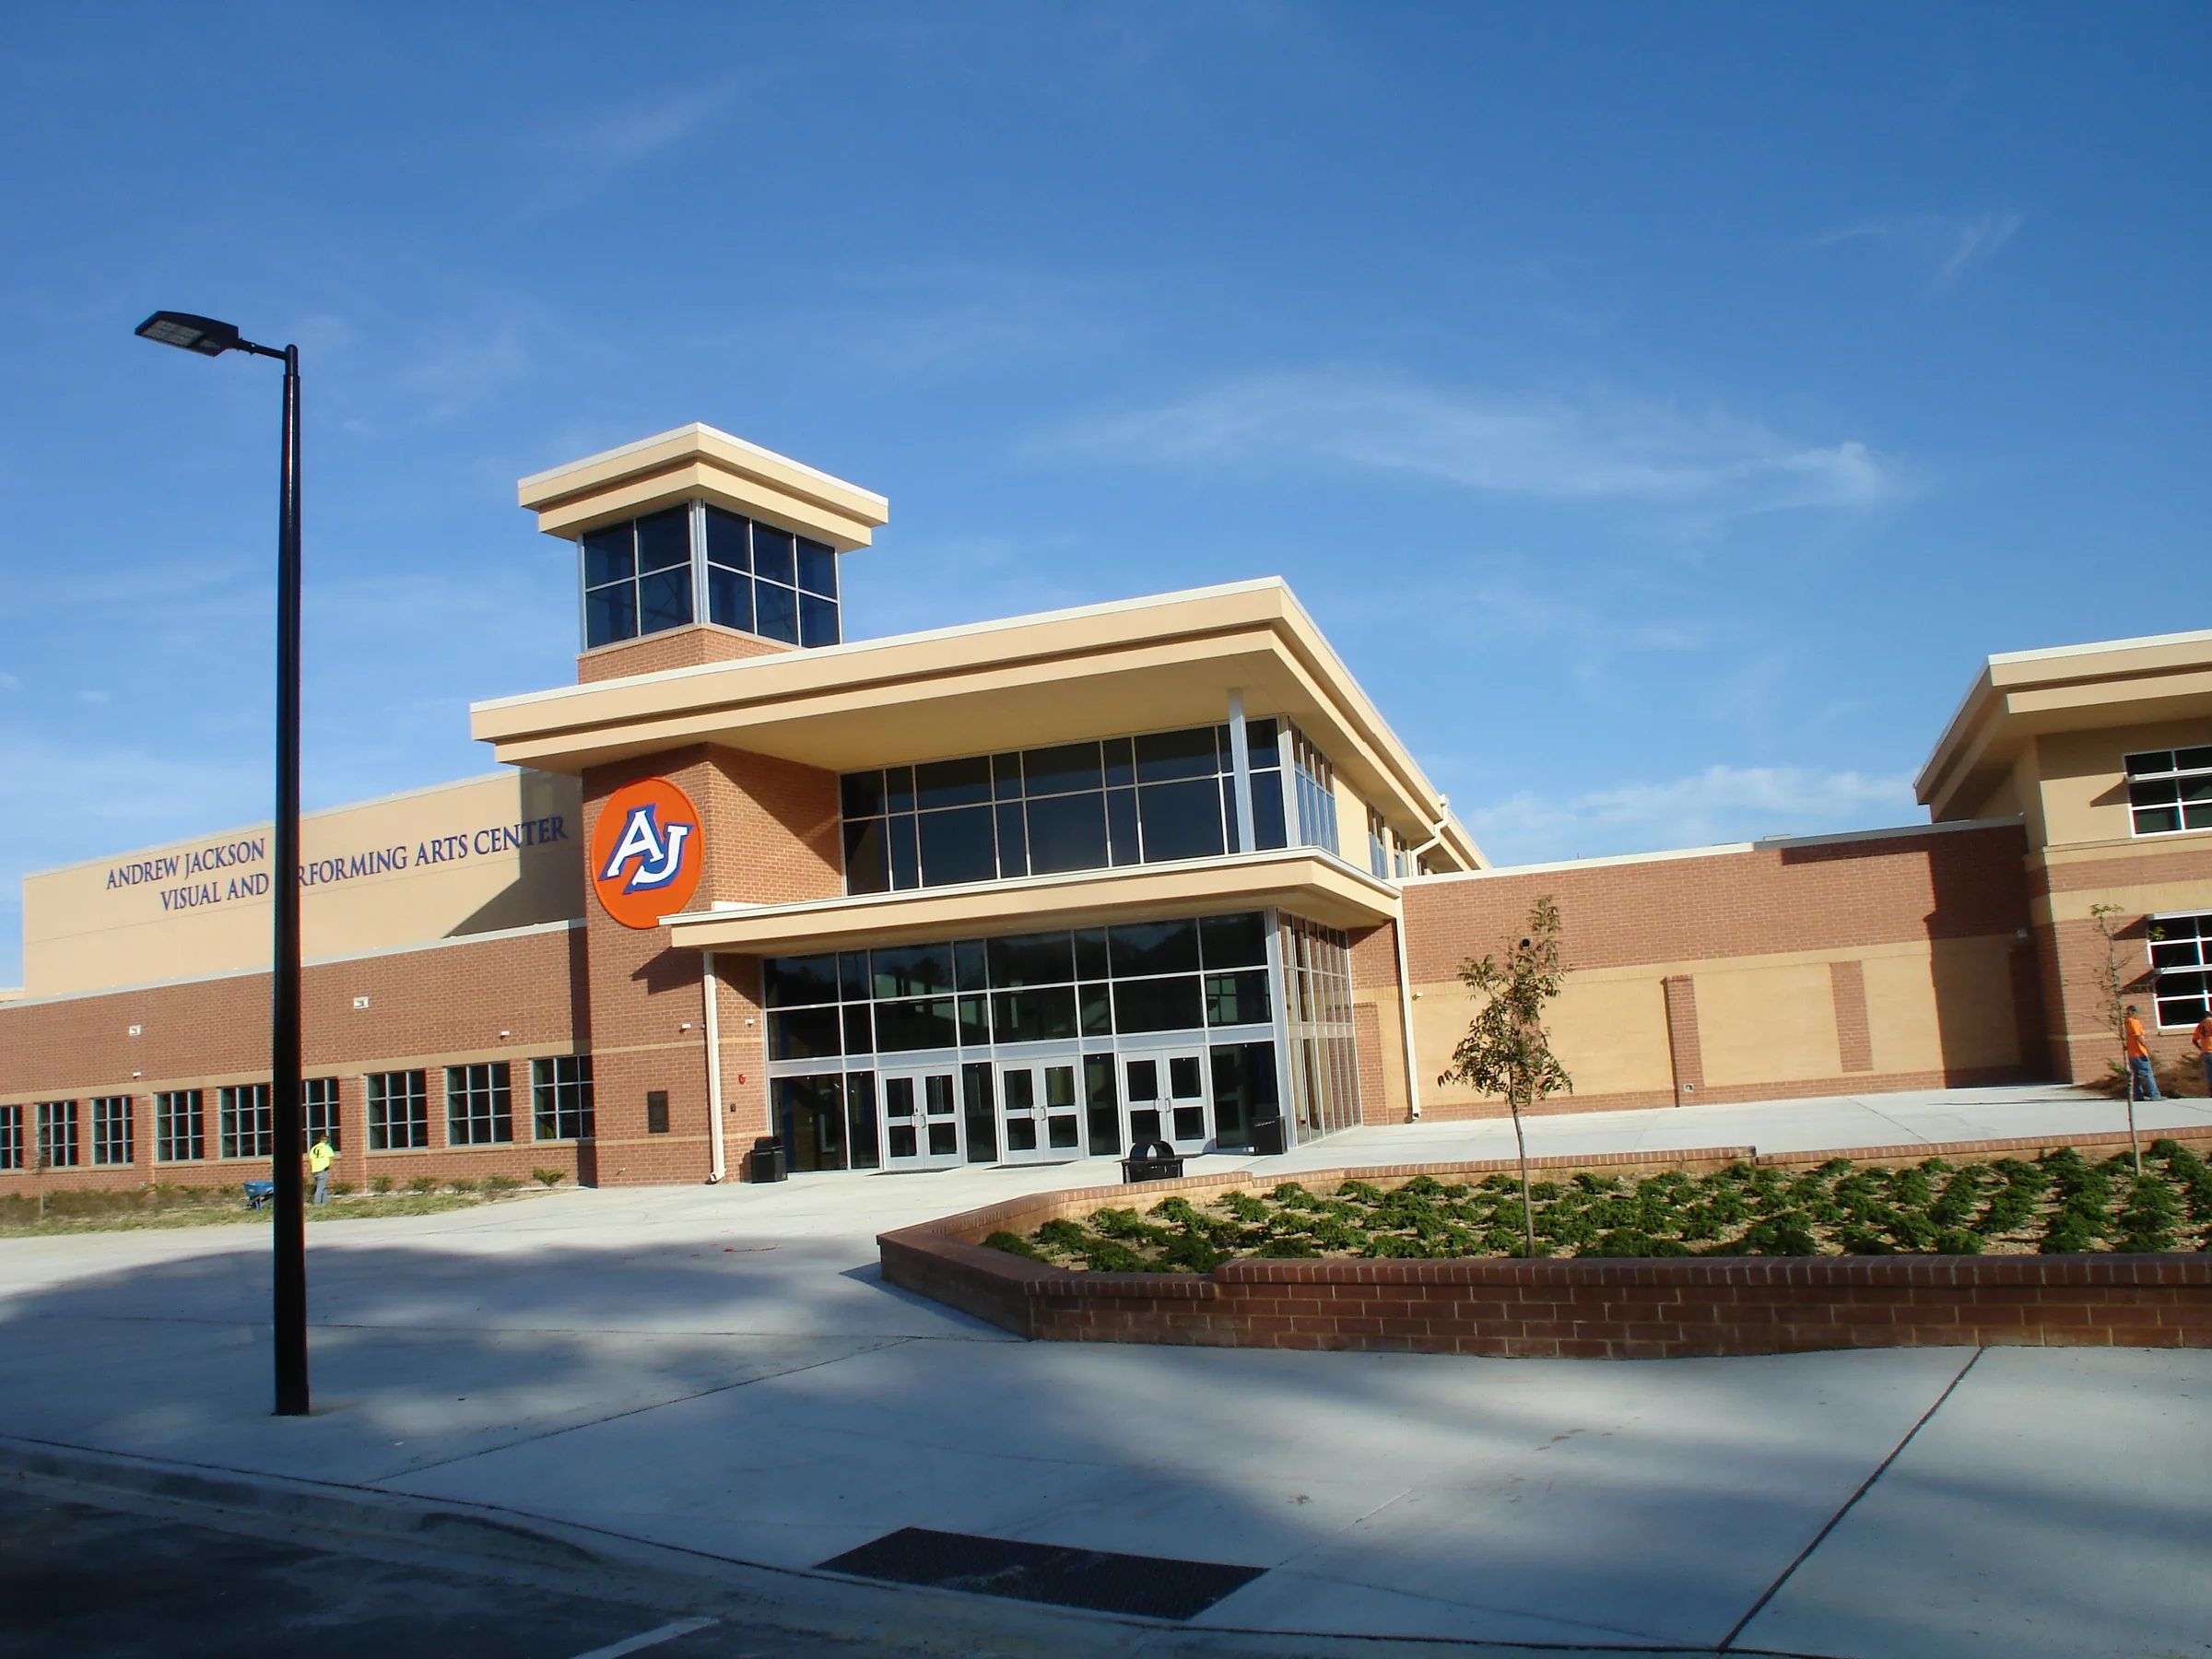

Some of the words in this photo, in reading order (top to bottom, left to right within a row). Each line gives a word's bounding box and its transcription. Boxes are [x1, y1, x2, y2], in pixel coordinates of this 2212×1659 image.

[106, 855, 181, 890] ANDREW
[184, 837, 265, 880] JACKSON
[160, 881, 222, 912] VISUAL
[227, 872, 270, 900] AND
[297, 845, 408, 887] RFORMING
[415, 834, 468, 866] ARTS
[474, 816, 568, 854] CENTER
[599, 804, 694, 895] AJ
